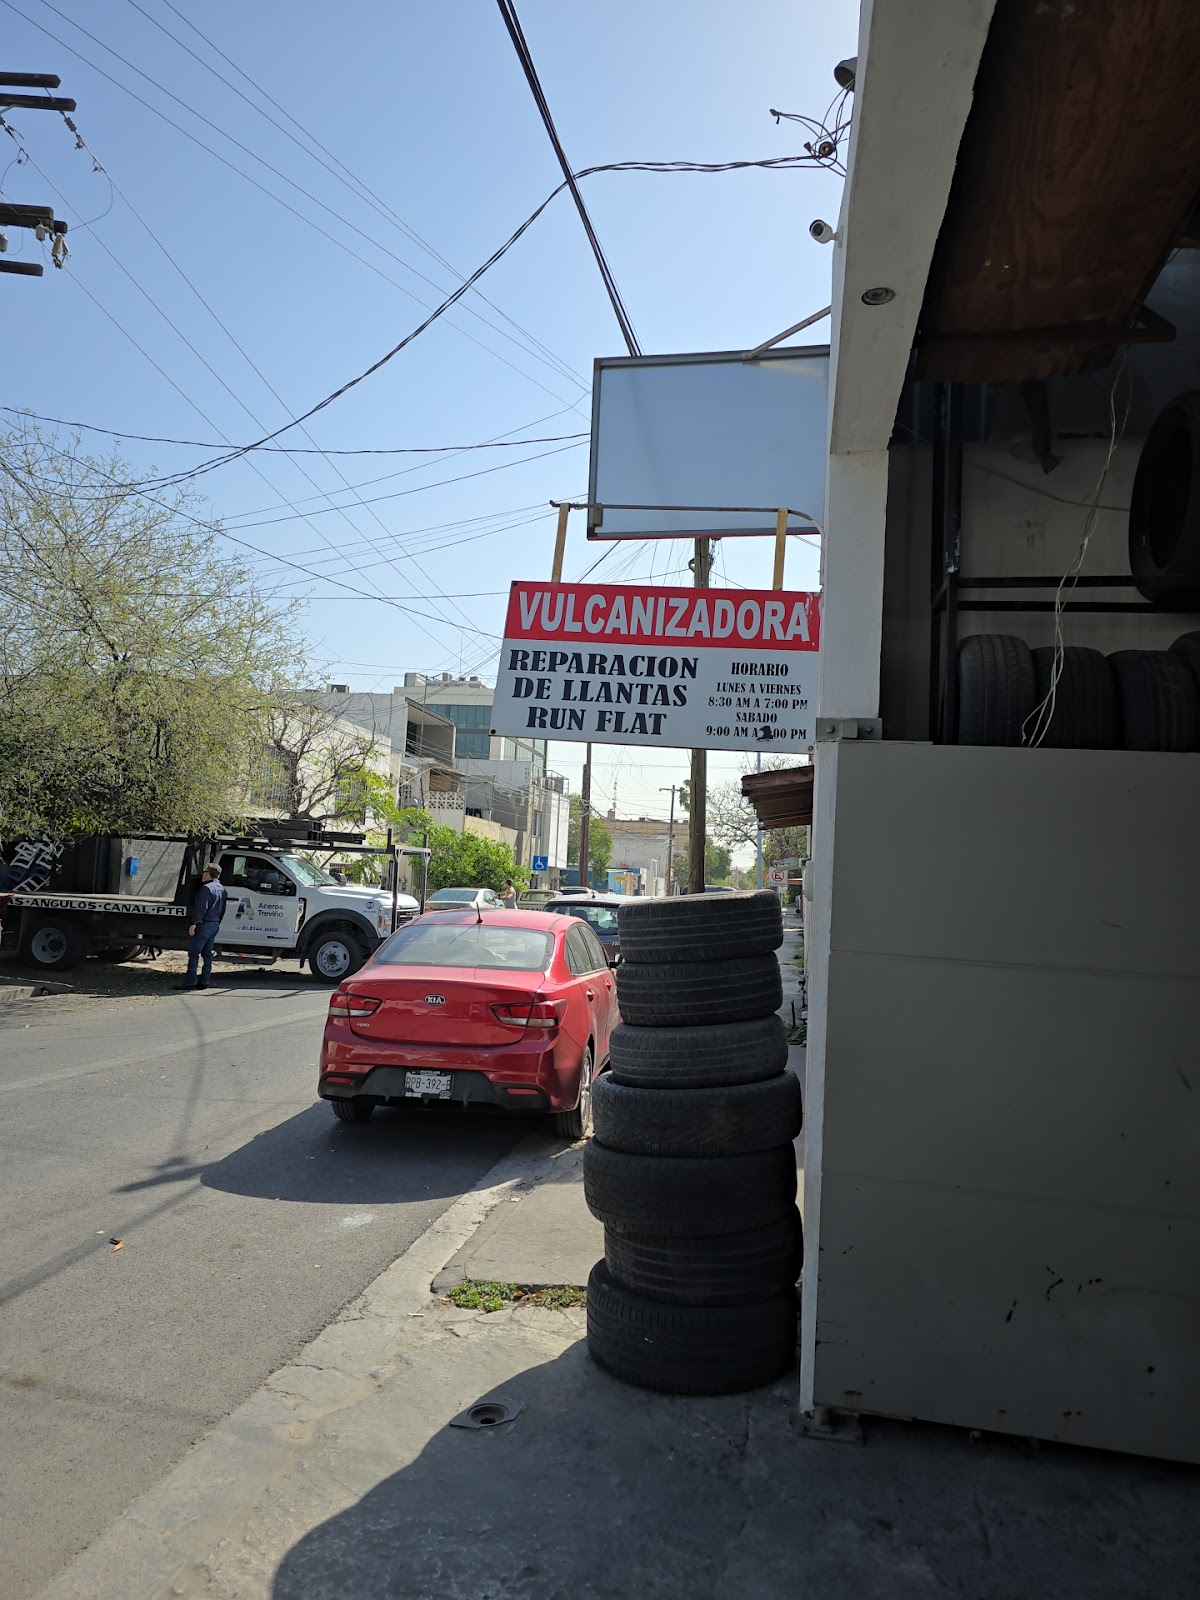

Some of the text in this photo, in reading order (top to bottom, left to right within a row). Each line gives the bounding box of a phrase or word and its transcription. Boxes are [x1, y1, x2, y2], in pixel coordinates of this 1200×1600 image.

[518, 590, 811, 642] VULCANIZADORA
[508, 649, 699, 679] REPARACION
[730, 662, 789, 677] HORARIO
[512, 677, 687, 707] DE LLANTAS
[716, 682, 802, 695] LUNES A VIERNES
[708, 696, 808, 710] 8:30 AM A 7:00 PM
[526, 706, 667, 736] RUN FLAT
[735, 712, 778, 723] SABADO
[706, 725, 730, 736] 9:00
[733, 726, 748, 737] AM
[751, 727, 758, 738] A
[790, 729, 807, 740] PM
[156, 906, 185, 916] PTR
[258, 902, 284, 910] Aceros
[257, 909, 284, 918] Treviño
[427, 996, 442, 1004] KIA
